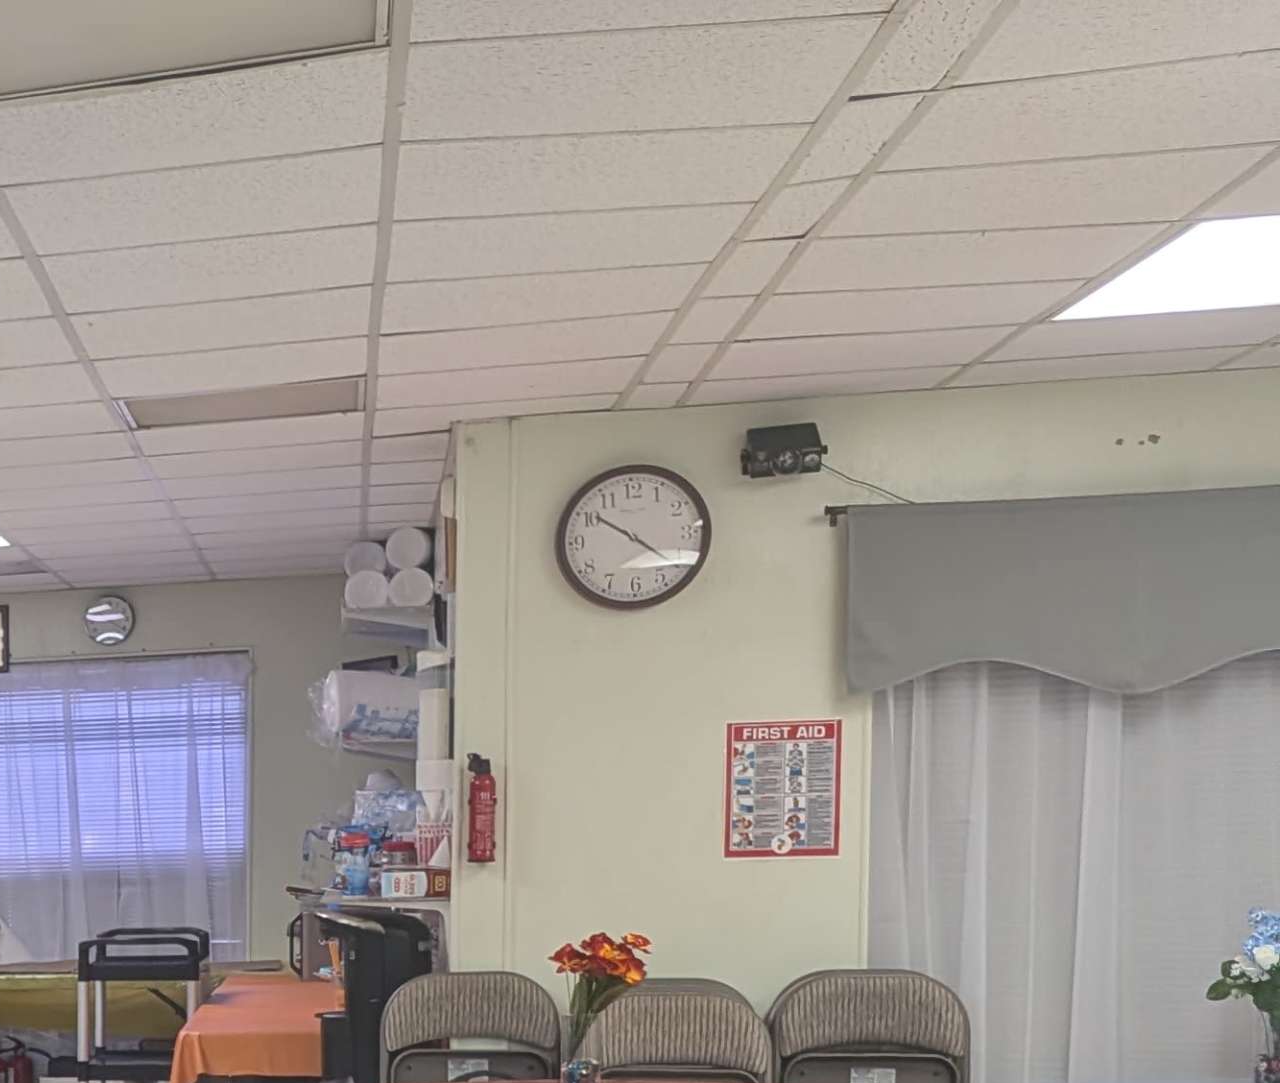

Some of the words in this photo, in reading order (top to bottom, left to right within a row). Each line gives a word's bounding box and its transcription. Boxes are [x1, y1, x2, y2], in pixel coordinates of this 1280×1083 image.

[624, 482, 642, 499] 12
[653, 486, 660, 503] 1
[601, 492, 616, 509] 11
[671, 500, 683, 517] 2
[681, 525, 693, 540] 3
[574, 535, 585, 552] 9
[583, 559, 596, 575] 8
[604, 573, 616, 590] 7
[630, 575, 642, 593] 6
[654, 568, 666, 584] 5
[742, 726, 791, 740] FIRST
[796, 725, 826, 739] AID
